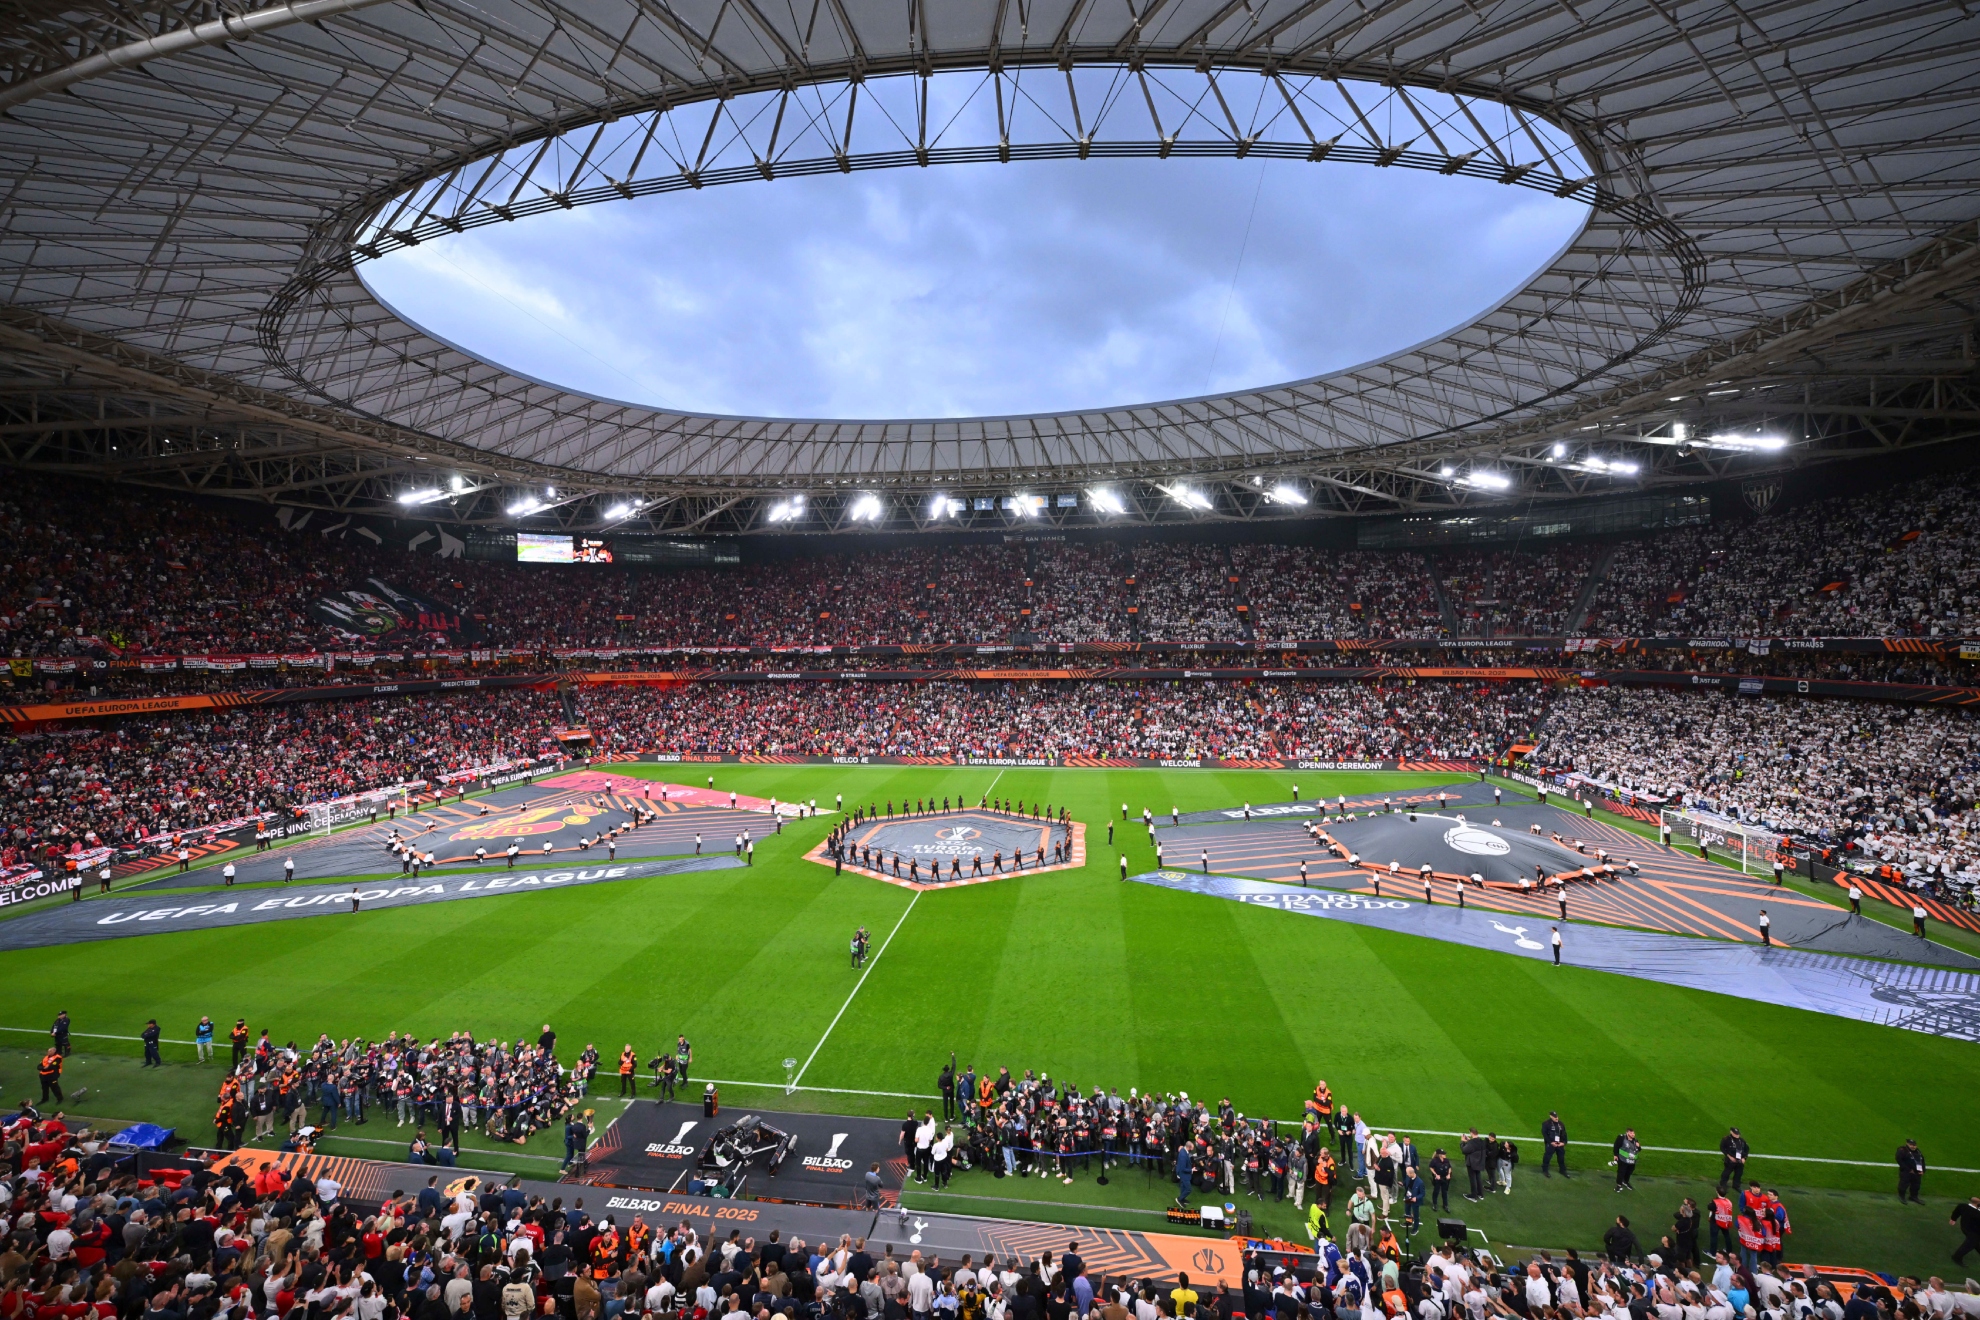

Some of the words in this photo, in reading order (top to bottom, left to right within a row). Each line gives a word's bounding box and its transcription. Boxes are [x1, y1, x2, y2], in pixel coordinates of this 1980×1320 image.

[1486, 639, 1513, 647] LEAGUE
[1792, 640, 1825, 648] STRAUSS
[109, 659, 141, 668] FINAL
[441, 680, 464, 688] PREDICT
[65, 705, 96, 715] UEFA
[98, 703, 139, 713] EUROPA
[142, 700, 180, 710] LEAGUE
[968, 758, 987, 766] UEFA
[988, 758, 1016, 766] EUROPA
[1017, 758, 1045, 766] LEAGUE
[1160, 760, 1201, 768] WELCOME
[1298, 761, 1335, 770] OPENING
[1336, 762, 1383, 770] CEREMONY
[532, 766, 554, 777] LEAGUE
[1511, 771, 1525, 783] UEFA
[1545, 782, 1568, 797] LEAGUE
[269, 820, 312, 840] PENING
[313, 806, 371, 828] CEREMONY
[912, 844, 984, 852] EUROPA
[1764, 850, 1797, 869] 2025
[0, 876, 76, 908] ELCOME
[96, 902, 239, 925] UEFA
[250, 882, 445, 912] EUROPA
[458, 866, 631, 892] LEAGUE
[1234, 894, 1276, 903] TO
[1282, 894, 1369, 903] DARE
[1285, 901, 1311, 910] IS
[1315, 901, 1364, 910] TO
[1364, 901, 1411, 911] DO
[662, 1202, 712, 1217] FINAL
[714, 1207, 760, 1222] 2025
